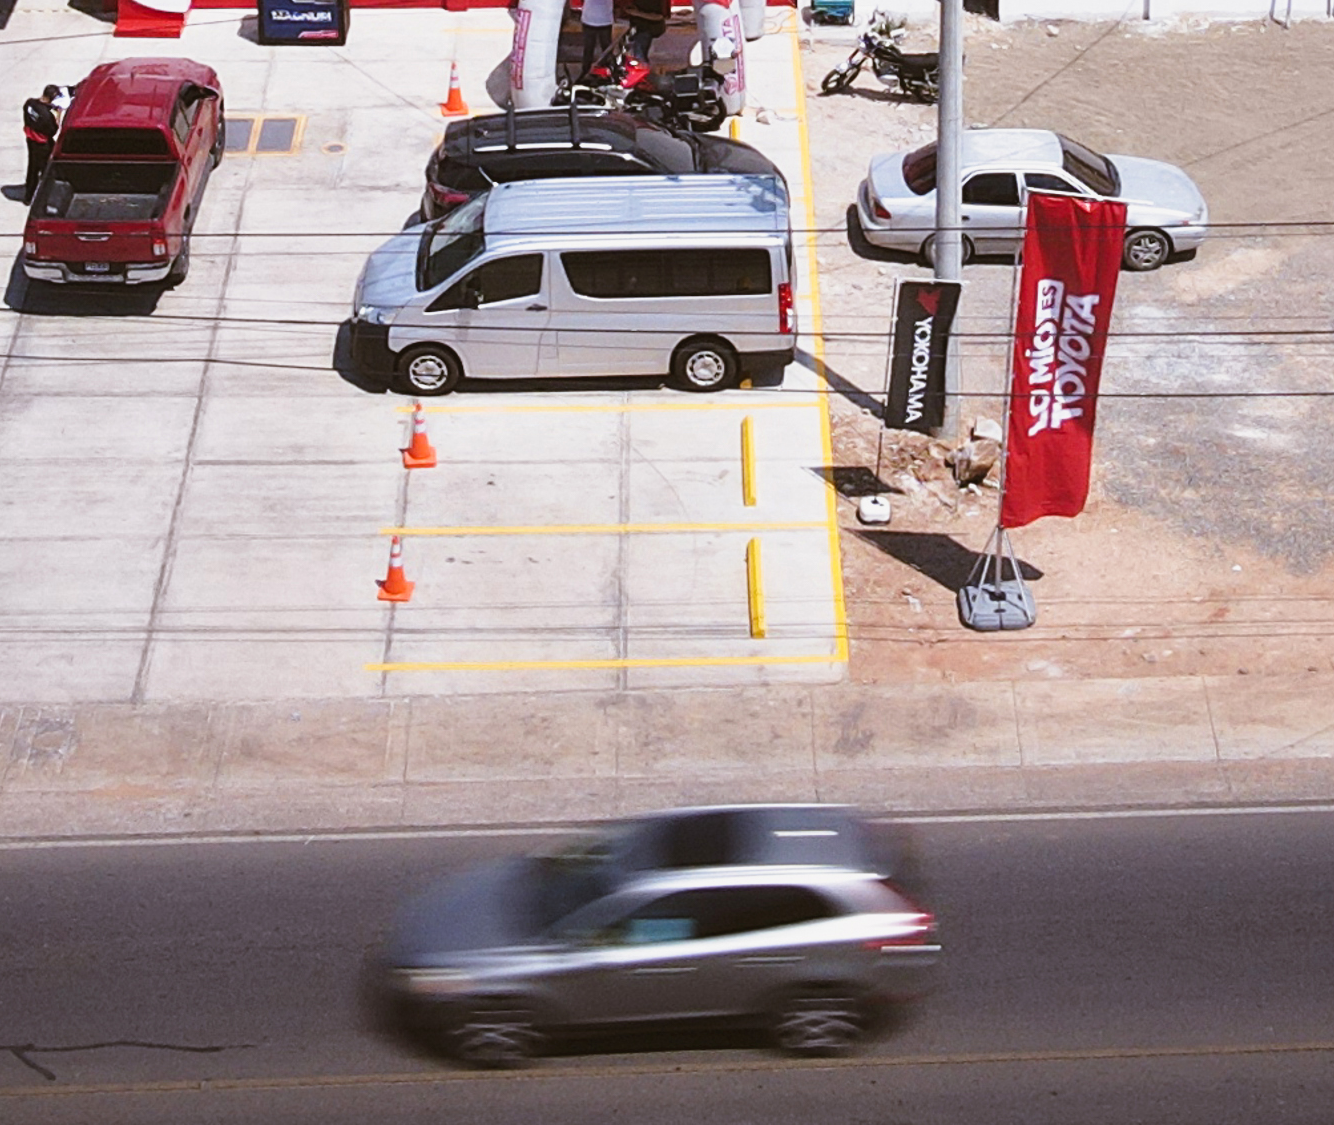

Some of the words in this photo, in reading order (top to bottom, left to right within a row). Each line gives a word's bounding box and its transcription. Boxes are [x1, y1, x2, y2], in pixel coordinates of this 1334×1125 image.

[904, 316, 934, 423] YOKOHAMA
[1027, 389, 1051, 437] LO
[1042, 285, 1057, 310] ES
[1050, 294, 1100, 428] TOYOTA
